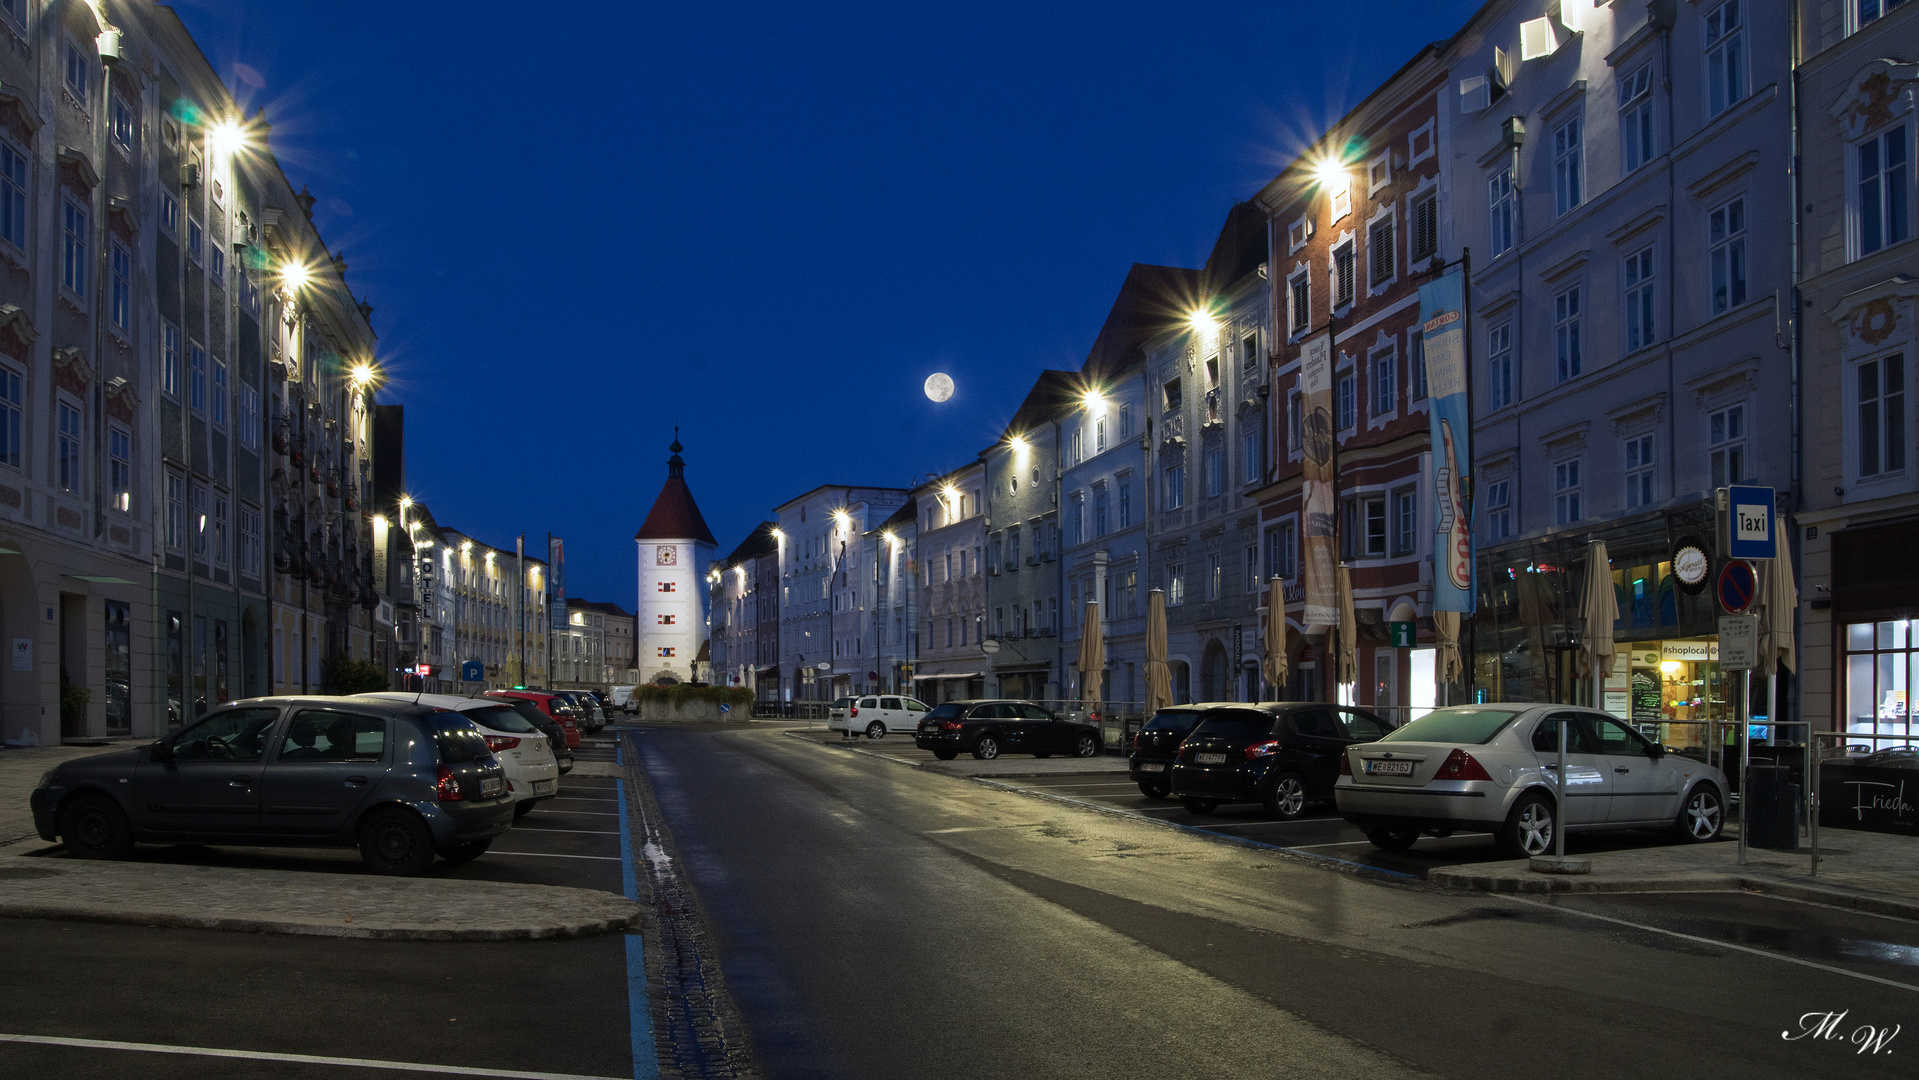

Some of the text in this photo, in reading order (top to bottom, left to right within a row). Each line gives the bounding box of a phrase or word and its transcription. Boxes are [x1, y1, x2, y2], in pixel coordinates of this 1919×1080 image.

[1739, 512, 1765, 531] Taxi
[422, 548, 432, 618] HOTEL
[1663, 646, 1708, 656] #shoplocal
[470, 668, 478, 679] P
[1372, 762, 1409, 772] WE 921GJ
